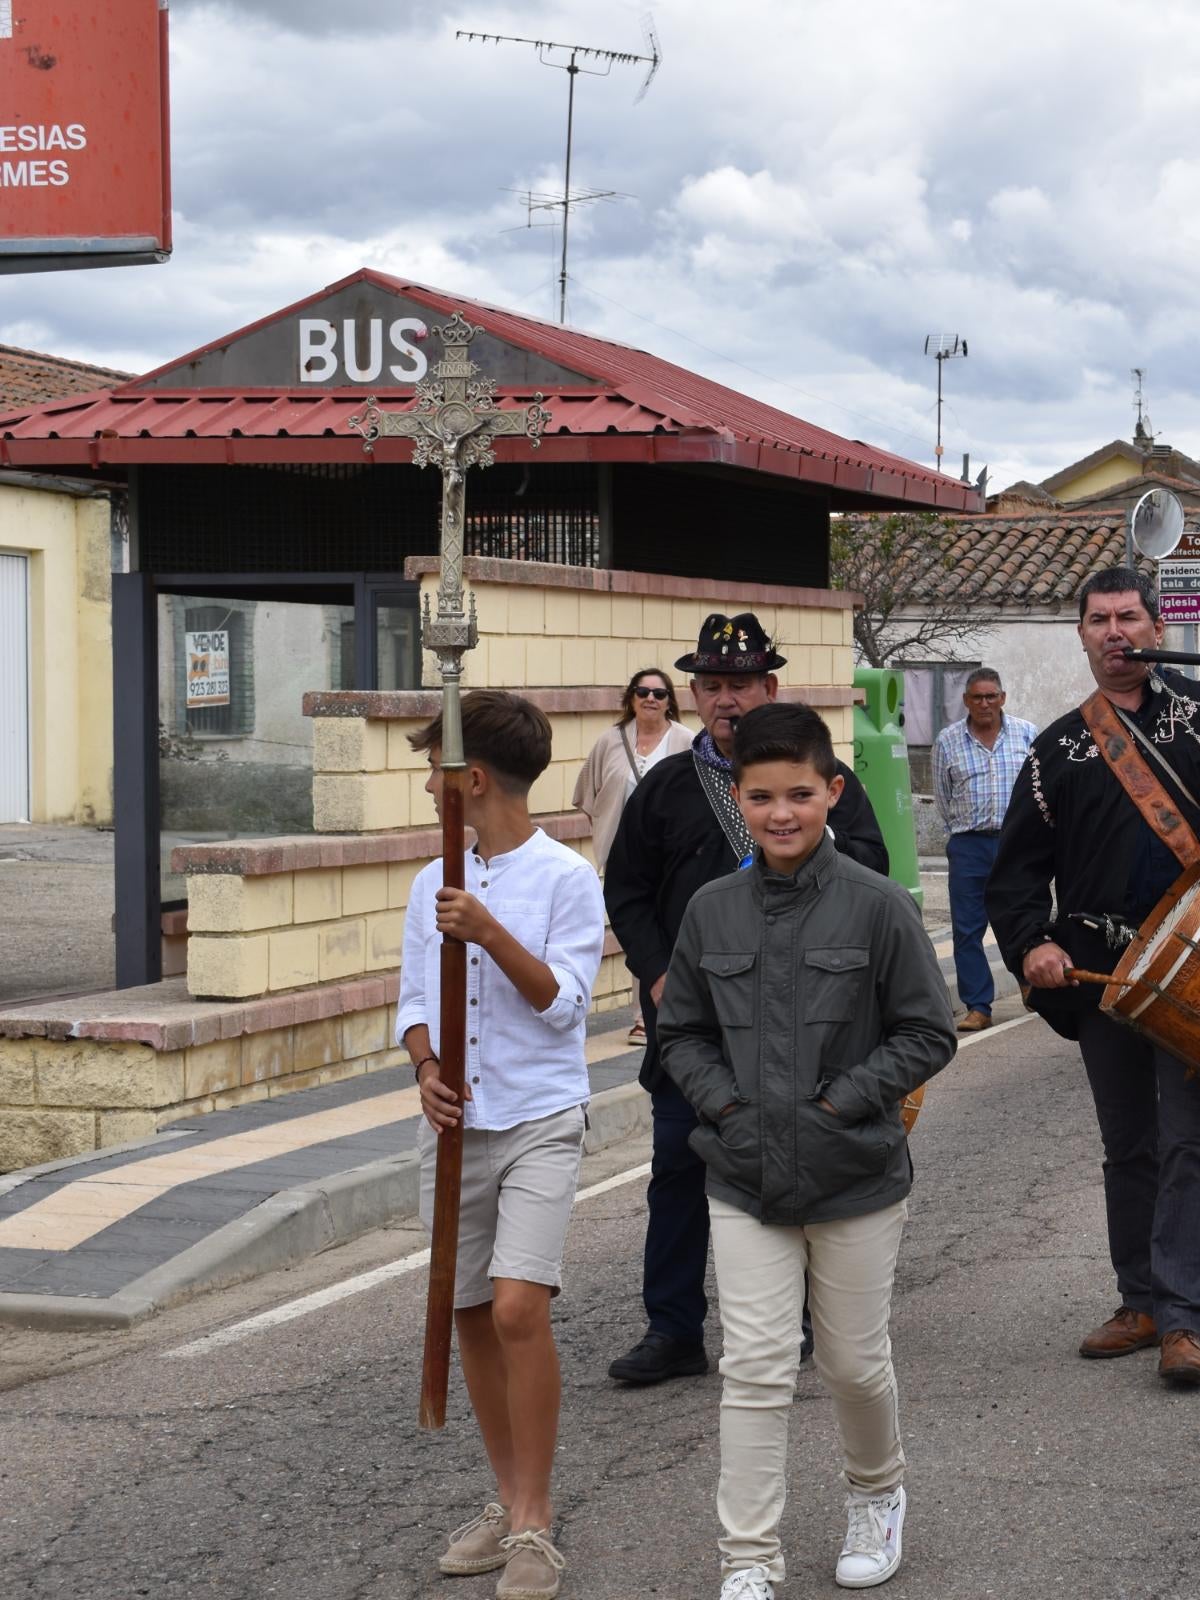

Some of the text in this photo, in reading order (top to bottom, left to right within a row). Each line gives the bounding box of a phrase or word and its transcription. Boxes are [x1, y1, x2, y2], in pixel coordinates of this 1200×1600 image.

[0, 160, 69, 187] MES
[298, 318, 427, 382] BUS
[1162, 579, 1184, 588] sala
[1161, 598, 1198, 609] iglesia
[193, 633, 225, 652] VENDE
[190, 683, 205, 696] 923
